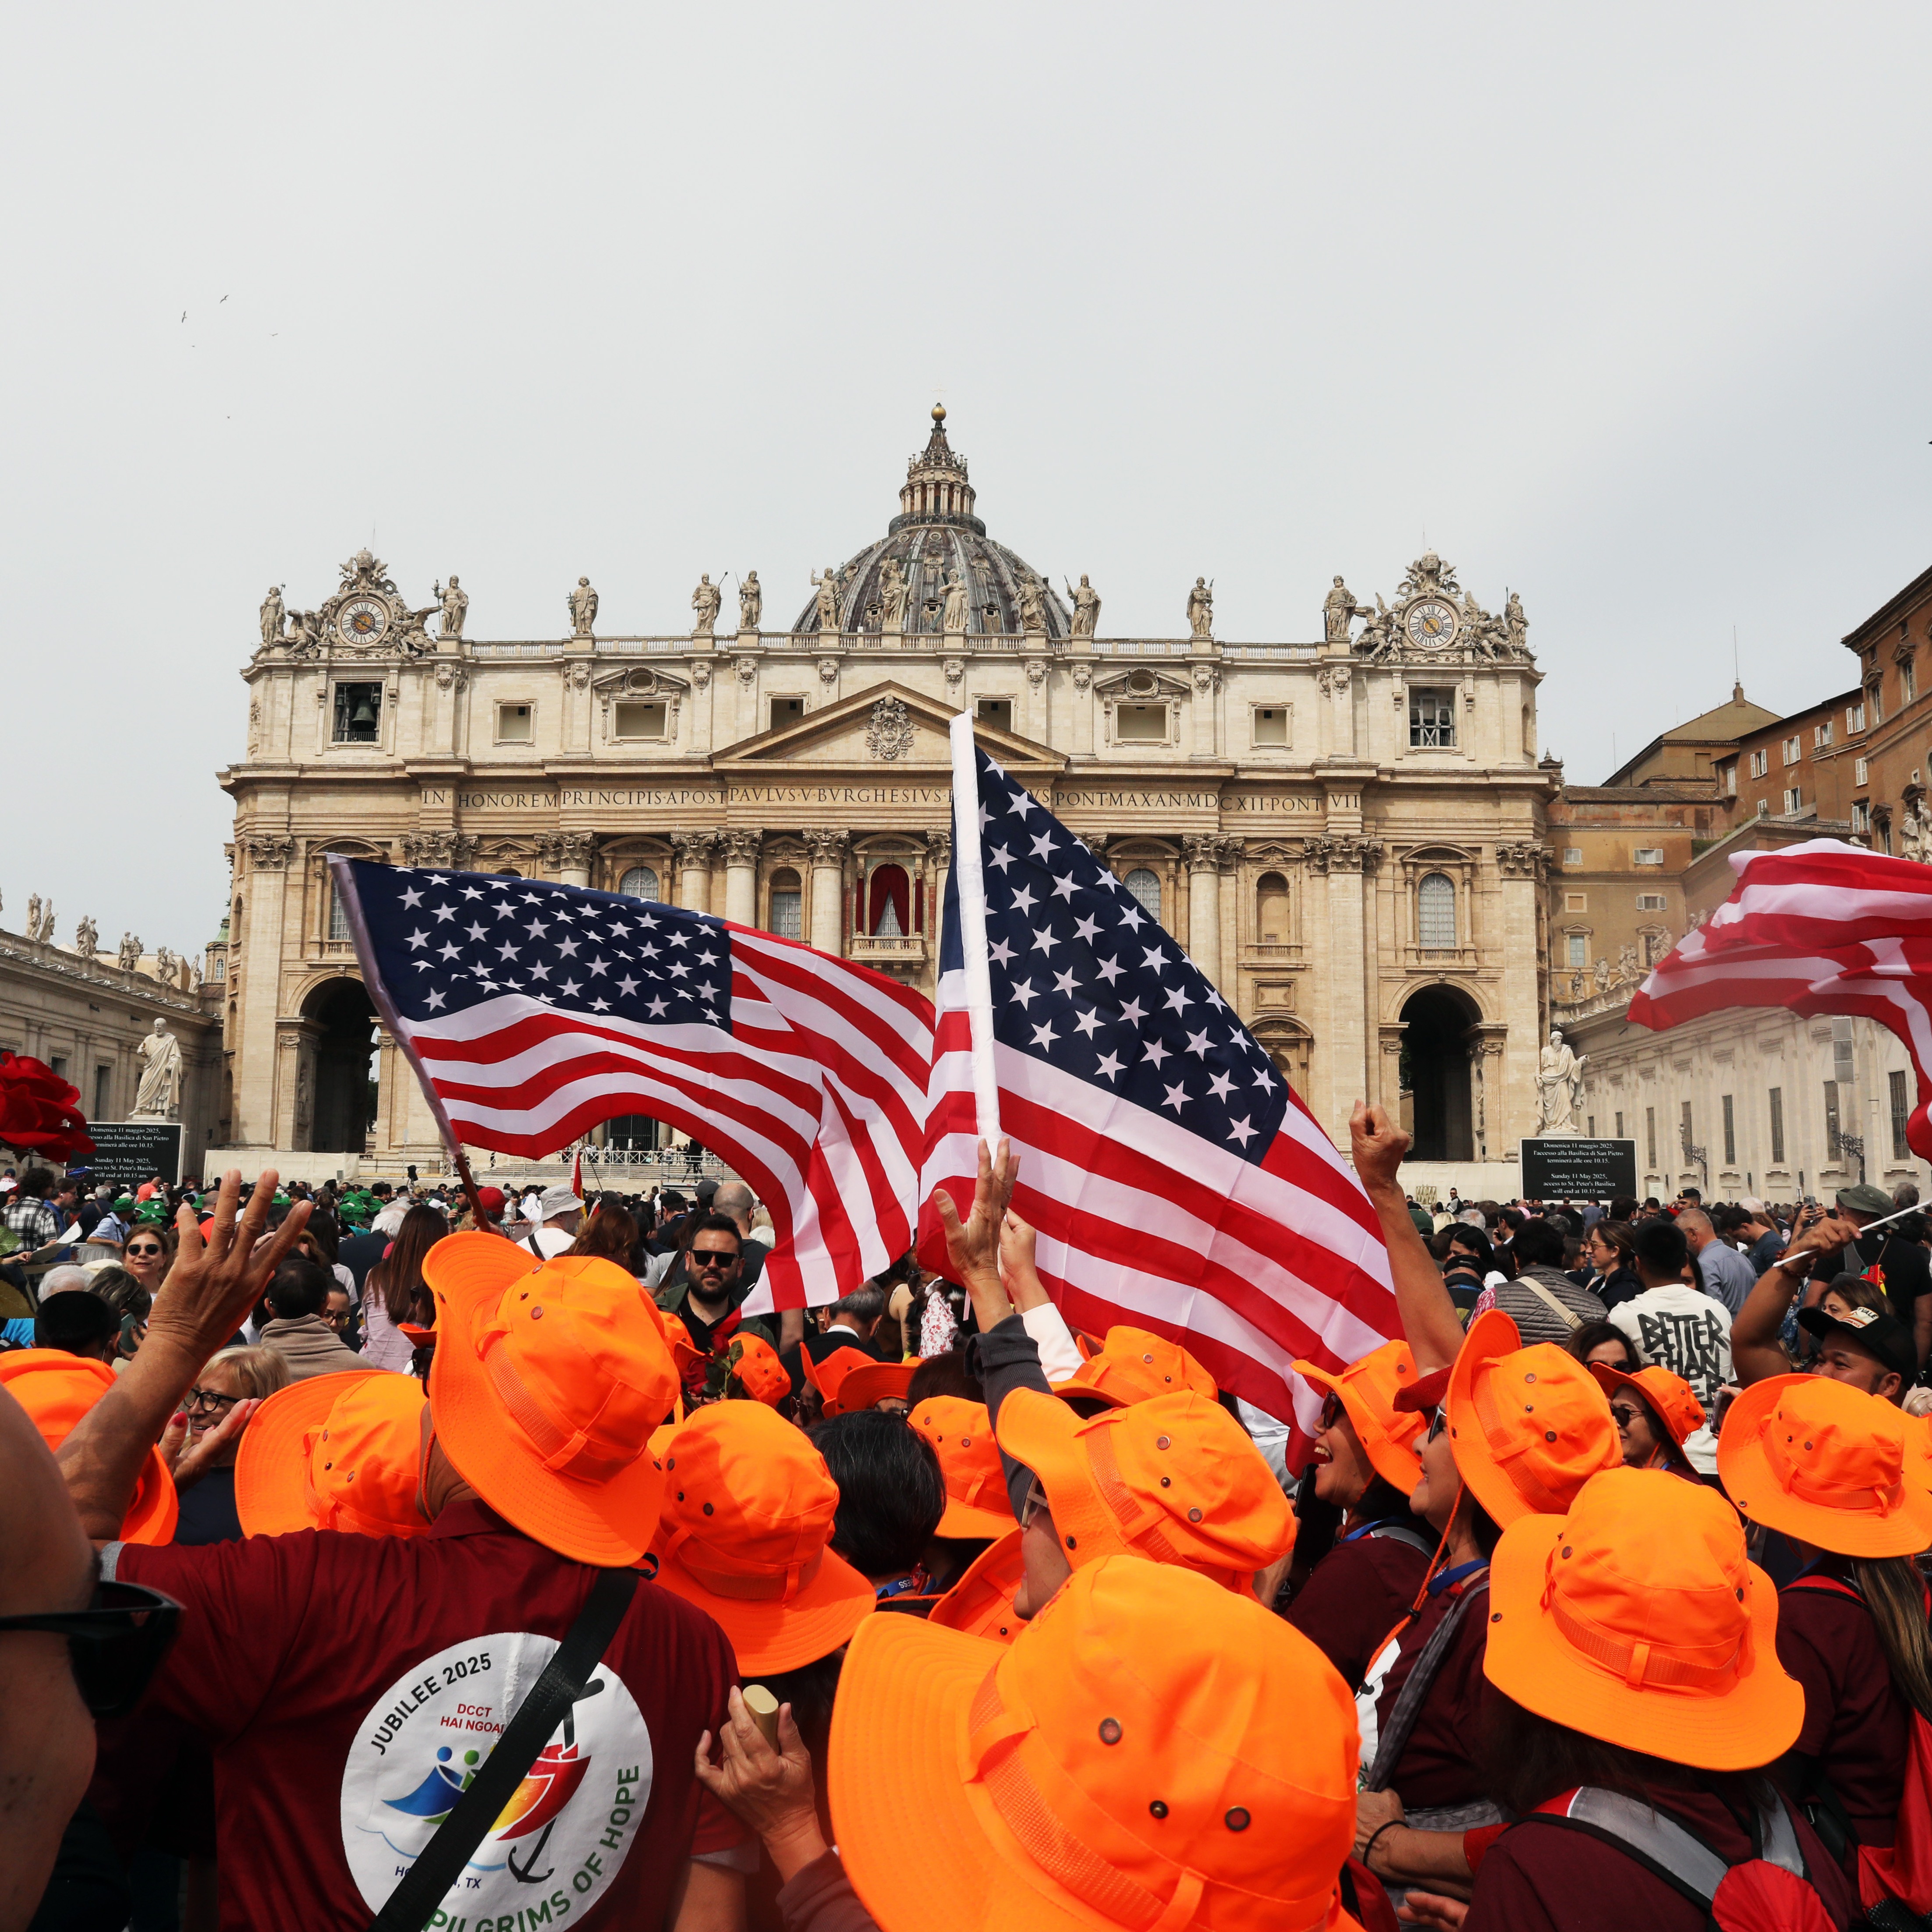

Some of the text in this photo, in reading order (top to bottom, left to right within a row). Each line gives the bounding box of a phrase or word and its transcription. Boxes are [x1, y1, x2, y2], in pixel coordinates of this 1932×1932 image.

[423, 791, 445, 804] IN
[458, 794, 558, 807] HONOREM
[563, 791, 662, 805] PRINCIPIS
[666, 791, 727, 805] APOST
[730, 787, 795, 802] PAVLVS
[799, 788, 811, 801] V
[818, 788, 941, 803] BVRGHESIVS
[1056, 792, 1107, 806] PONT
[1109, 793, 1152, 807] MAX
[1155, 794, 1181, 807] AN
[1271, 798, 1322, 811] PONT
[1330, 794, 1358, 808] VII
[1638, 1309, 1729, 1354] BETTER
[1649, 1341, 1720, 1375] THAN
[371, 1652, 491, 1756] JUBILEE 2025
[457, 1703, 493, 1717] DCCT
[440, 1716, 505, 1733] HAI NGOAI
[573, 1851, 603, 1893] OF
[599, 1765, 639, 1850] HOPE
[466, 1877, 482, 1889] TX
